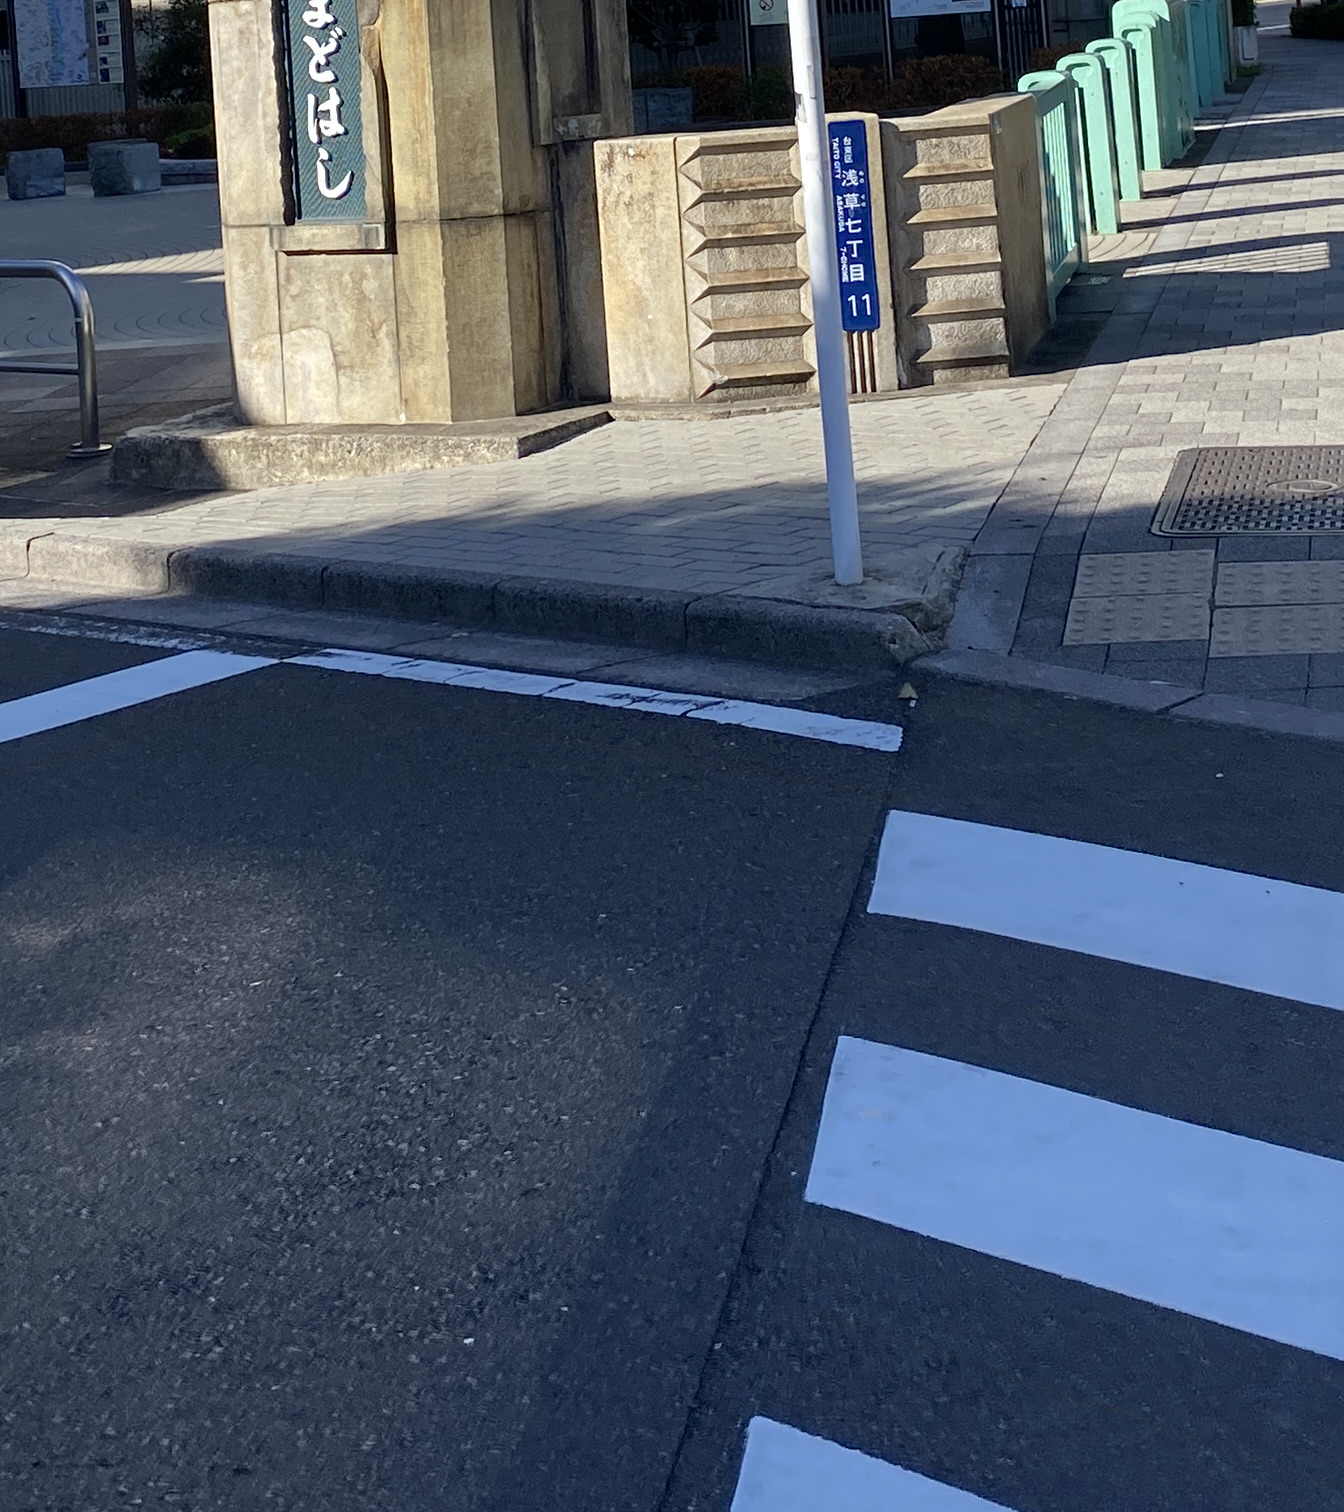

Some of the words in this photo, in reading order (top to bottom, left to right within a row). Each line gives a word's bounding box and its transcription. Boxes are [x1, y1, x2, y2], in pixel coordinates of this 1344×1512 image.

[831, 136, 840, 160] TAITO
[834, 161, 842, 180] CITY
[841, 168, 865, 282] 浅草七丁目
[847, 293, 872, 317] 11
